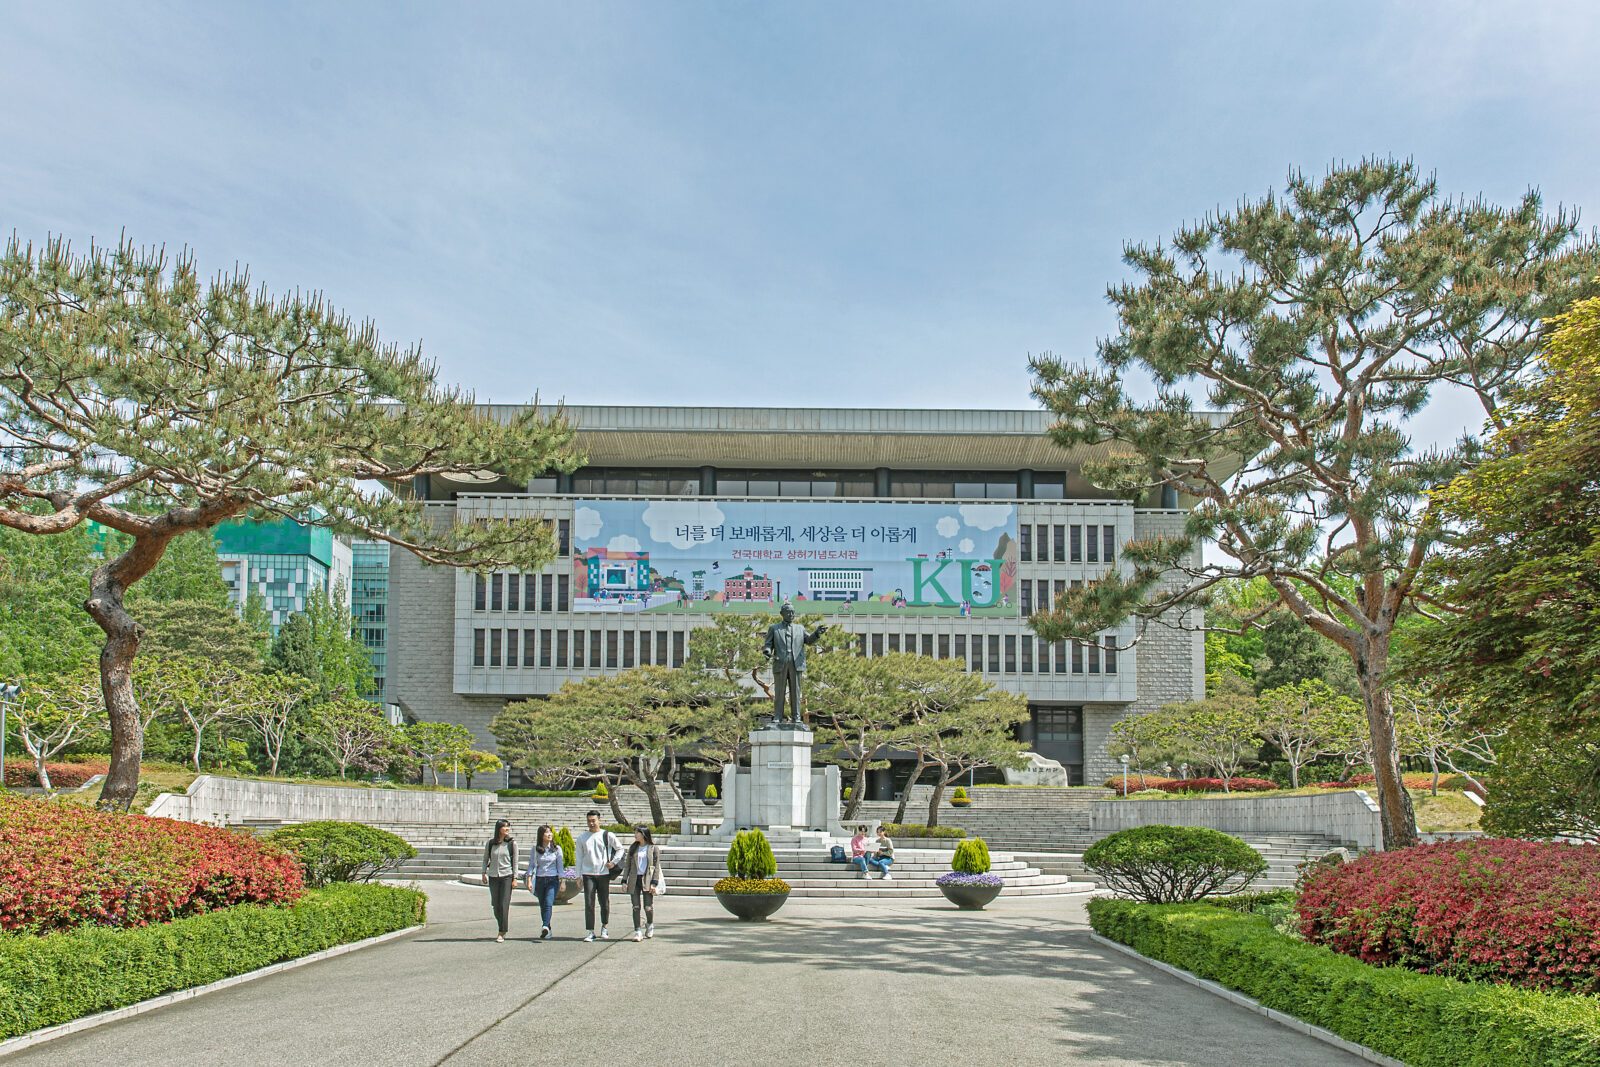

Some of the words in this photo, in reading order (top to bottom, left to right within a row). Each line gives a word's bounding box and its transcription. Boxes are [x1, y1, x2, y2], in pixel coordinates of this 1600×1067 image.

[676, 524, 707, 542] 너를
[710, 525, 725, 542] 더
[729, 525, 795, 544] 보배롭게,
[799, 525, 848, 543] 세상을
[851, 526, 866, 543] 더
[870, 526, 917, 544] 이롭게
[731, 549, 783, 560] 건국대학교
[786, 549, 859, 560] 상허기념도서관
[905, 557, 1006, 608] KU
